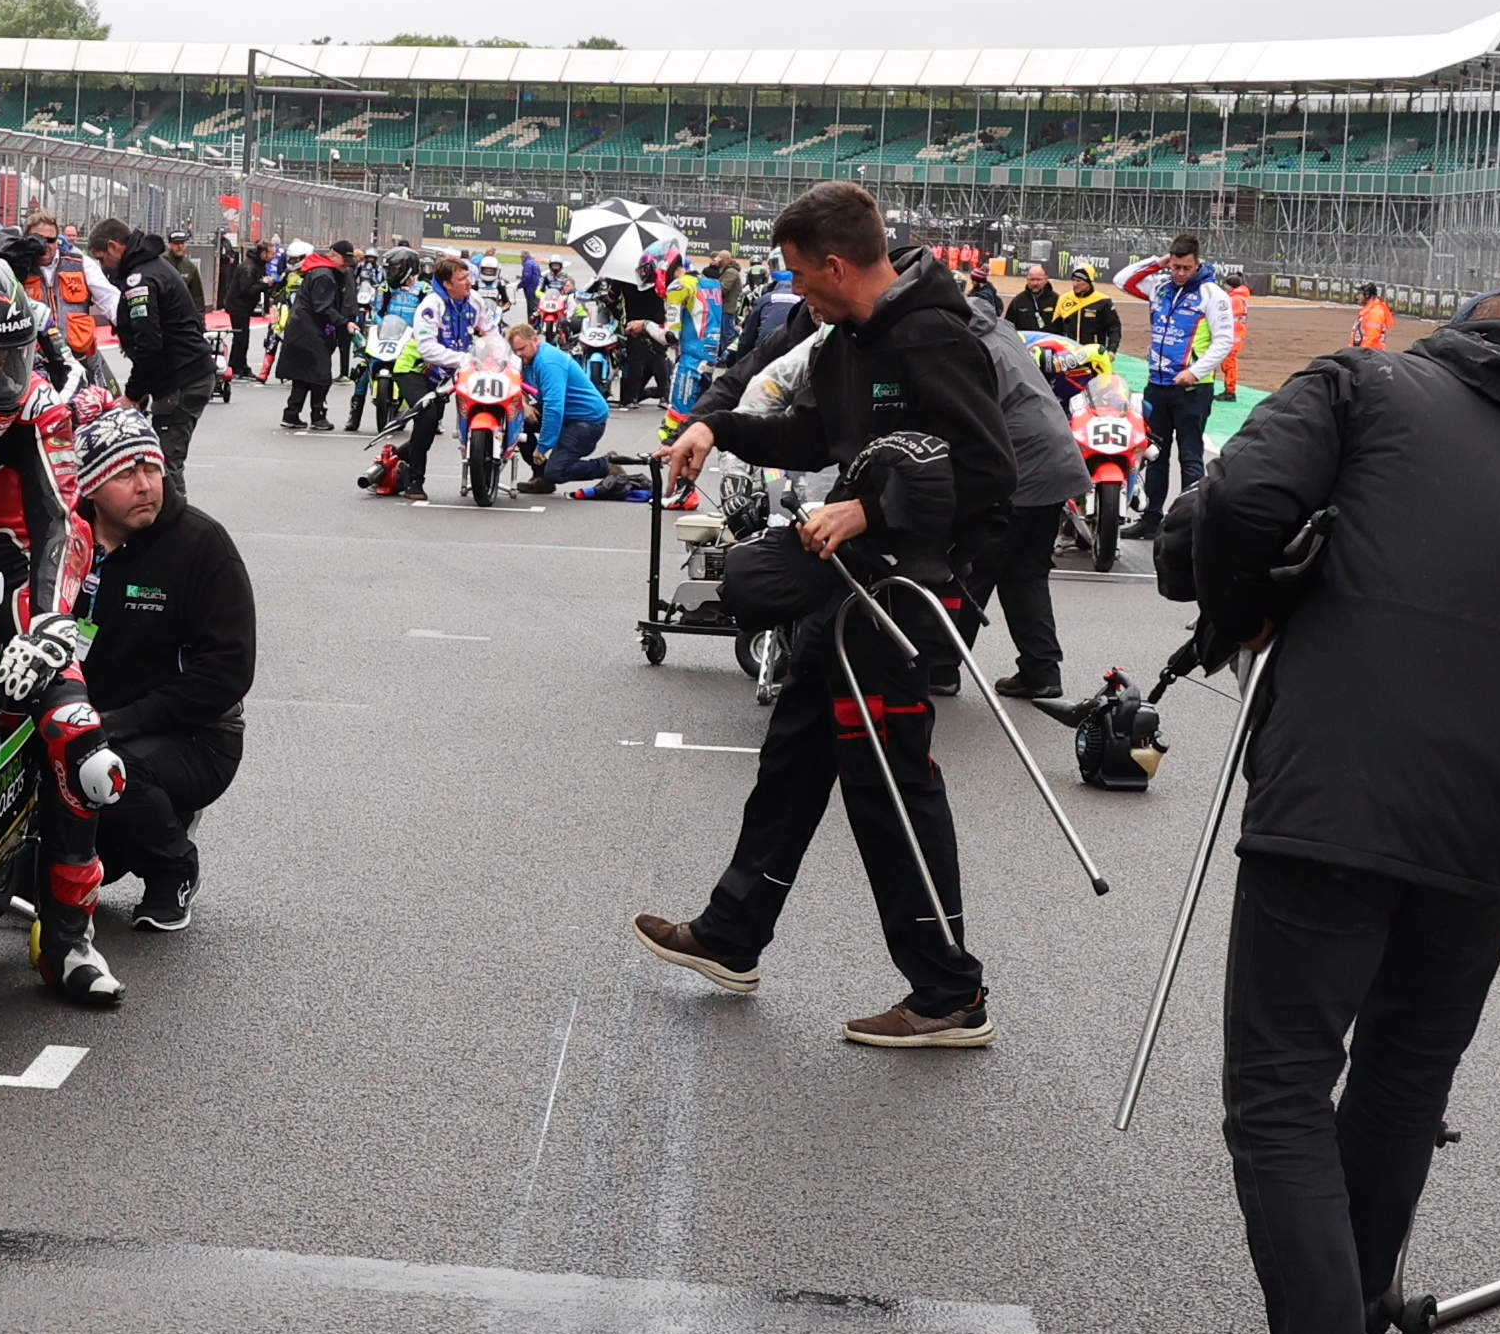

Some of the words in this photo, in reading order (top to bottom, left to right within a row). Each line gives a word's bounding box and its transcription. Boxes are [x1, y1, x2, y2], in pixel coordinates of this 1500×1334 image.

[484, 203, 536, 218] MONSTER
[450, 224, 481, 236] MONSTER
[507, 226, 537, 238] MONSTER
[1069, 255, 1110, 269] MONSTER
[377, 340, 399, 354] 75
[471, 378, 504, 399] 40
[1092, 422, 1128, 447] 55
